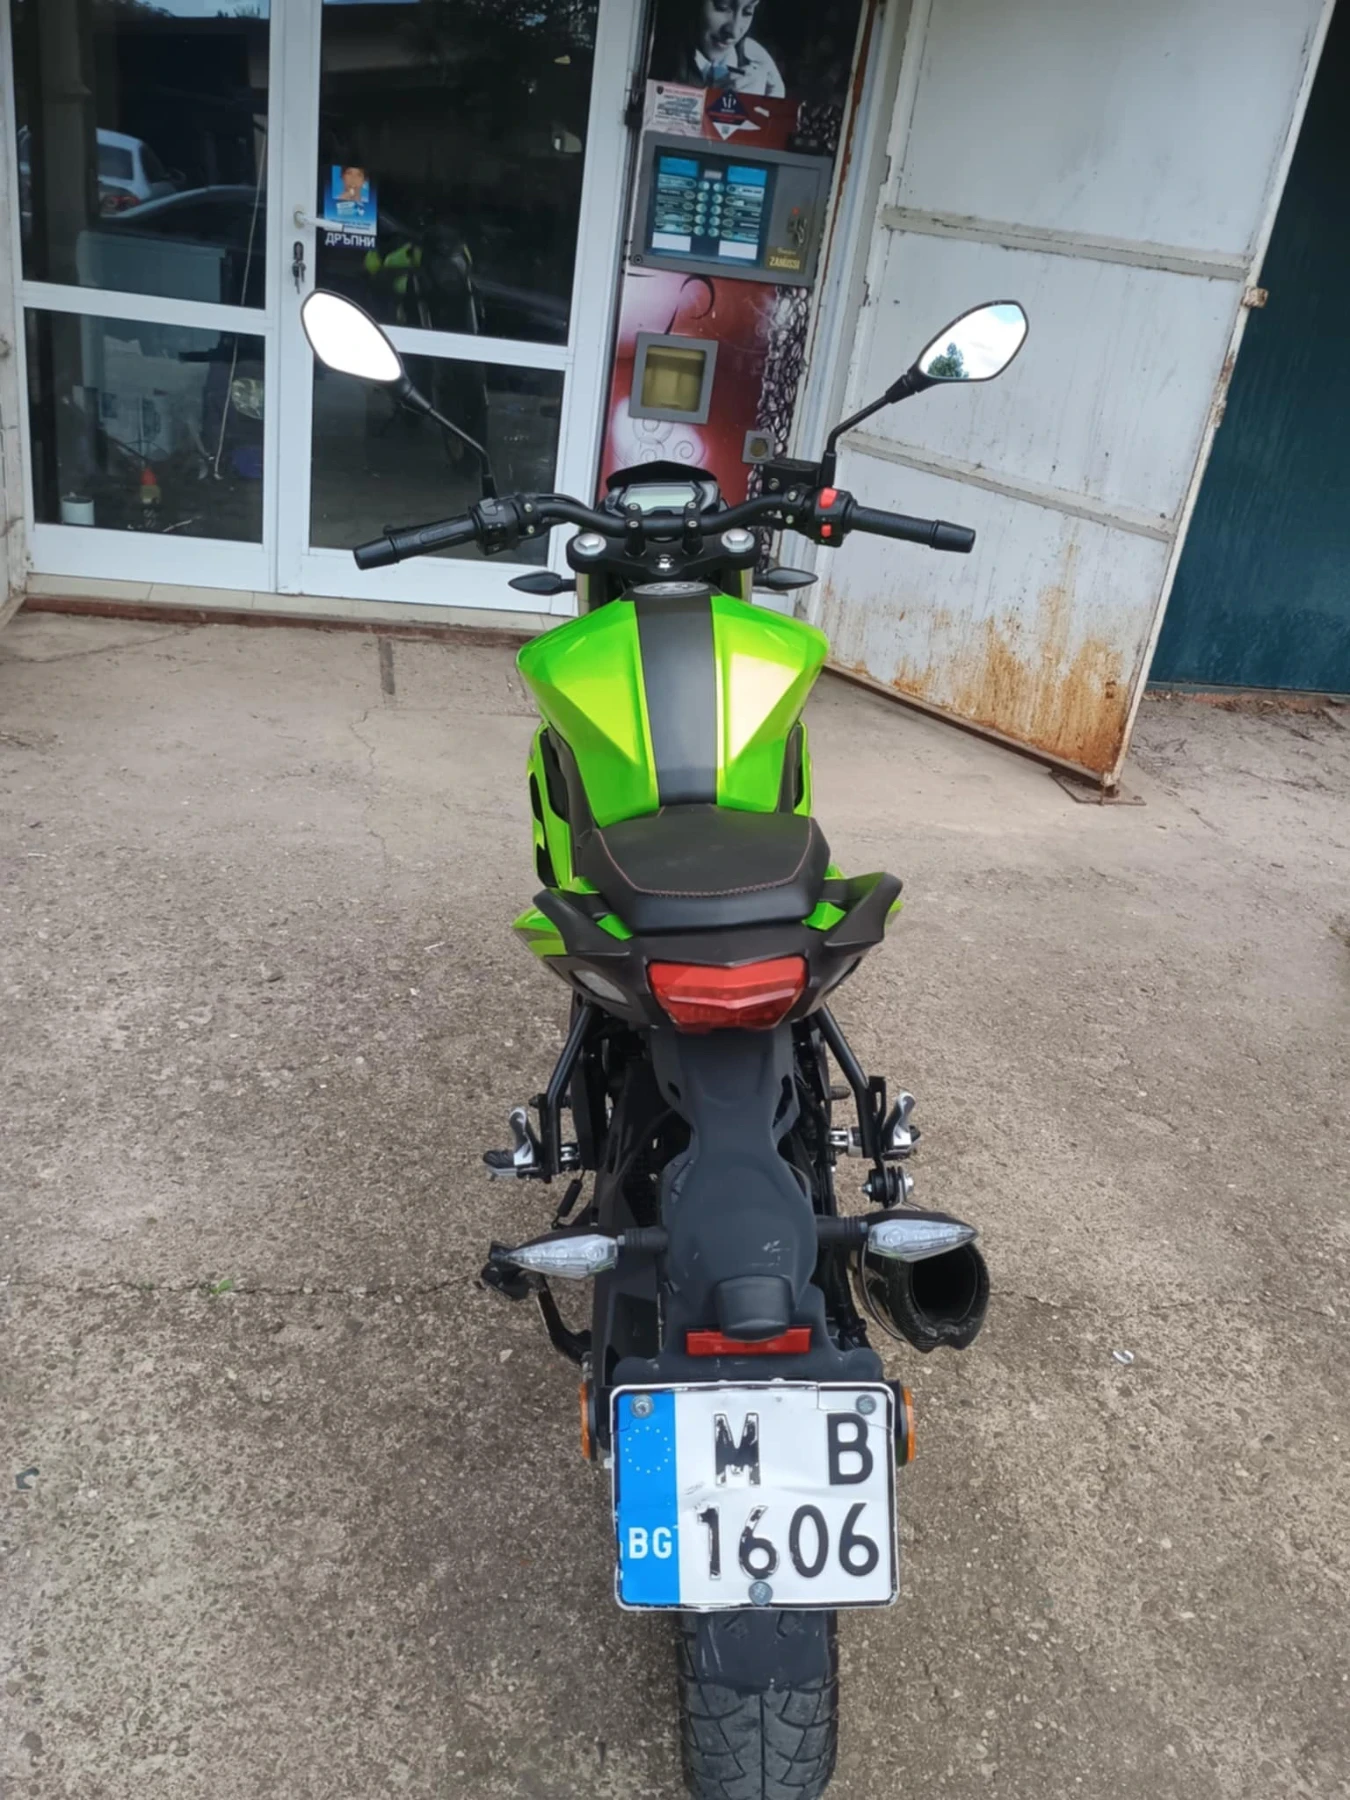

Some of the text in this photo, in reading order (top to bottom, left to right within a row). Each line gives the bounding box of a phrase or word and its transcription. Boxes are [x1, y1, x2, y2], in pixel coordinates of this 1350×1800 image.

[325, 232, 376, 248] ДРЪПНИ
[714, 1412, 874, 1486] M B
[628, 1527, 672, 1559] BG
[697, 1503, 880, 1580] 1606
